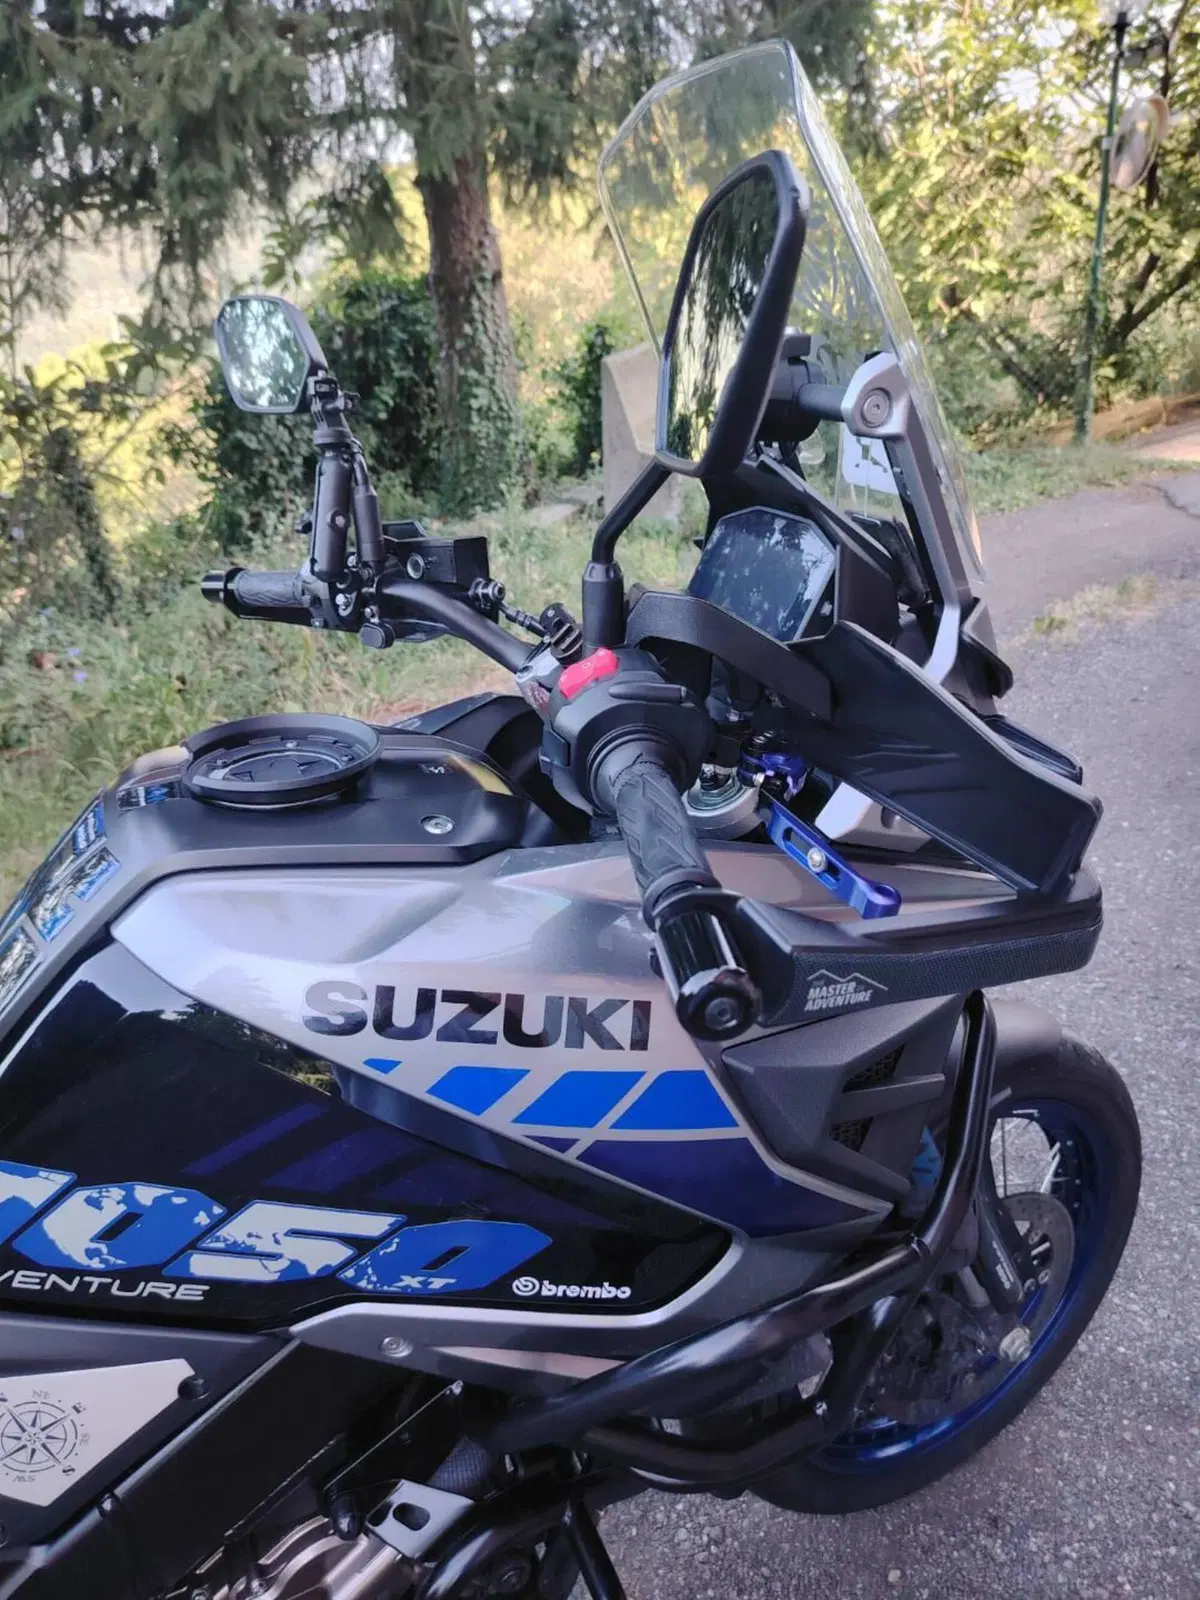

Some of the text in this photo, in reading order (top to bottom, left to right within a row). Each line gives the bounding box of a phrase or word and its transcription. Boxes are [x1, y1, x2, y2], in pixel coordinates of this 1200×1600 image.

[804, 989, 874, 1012] ADVENTURE
[807, 982, 857, 1001] MASTER
[302, 980, 652, 1051] SUZUKI
[394, 1276, 456, 1289] XT
[541, 1280, 632, 1299] brembo
